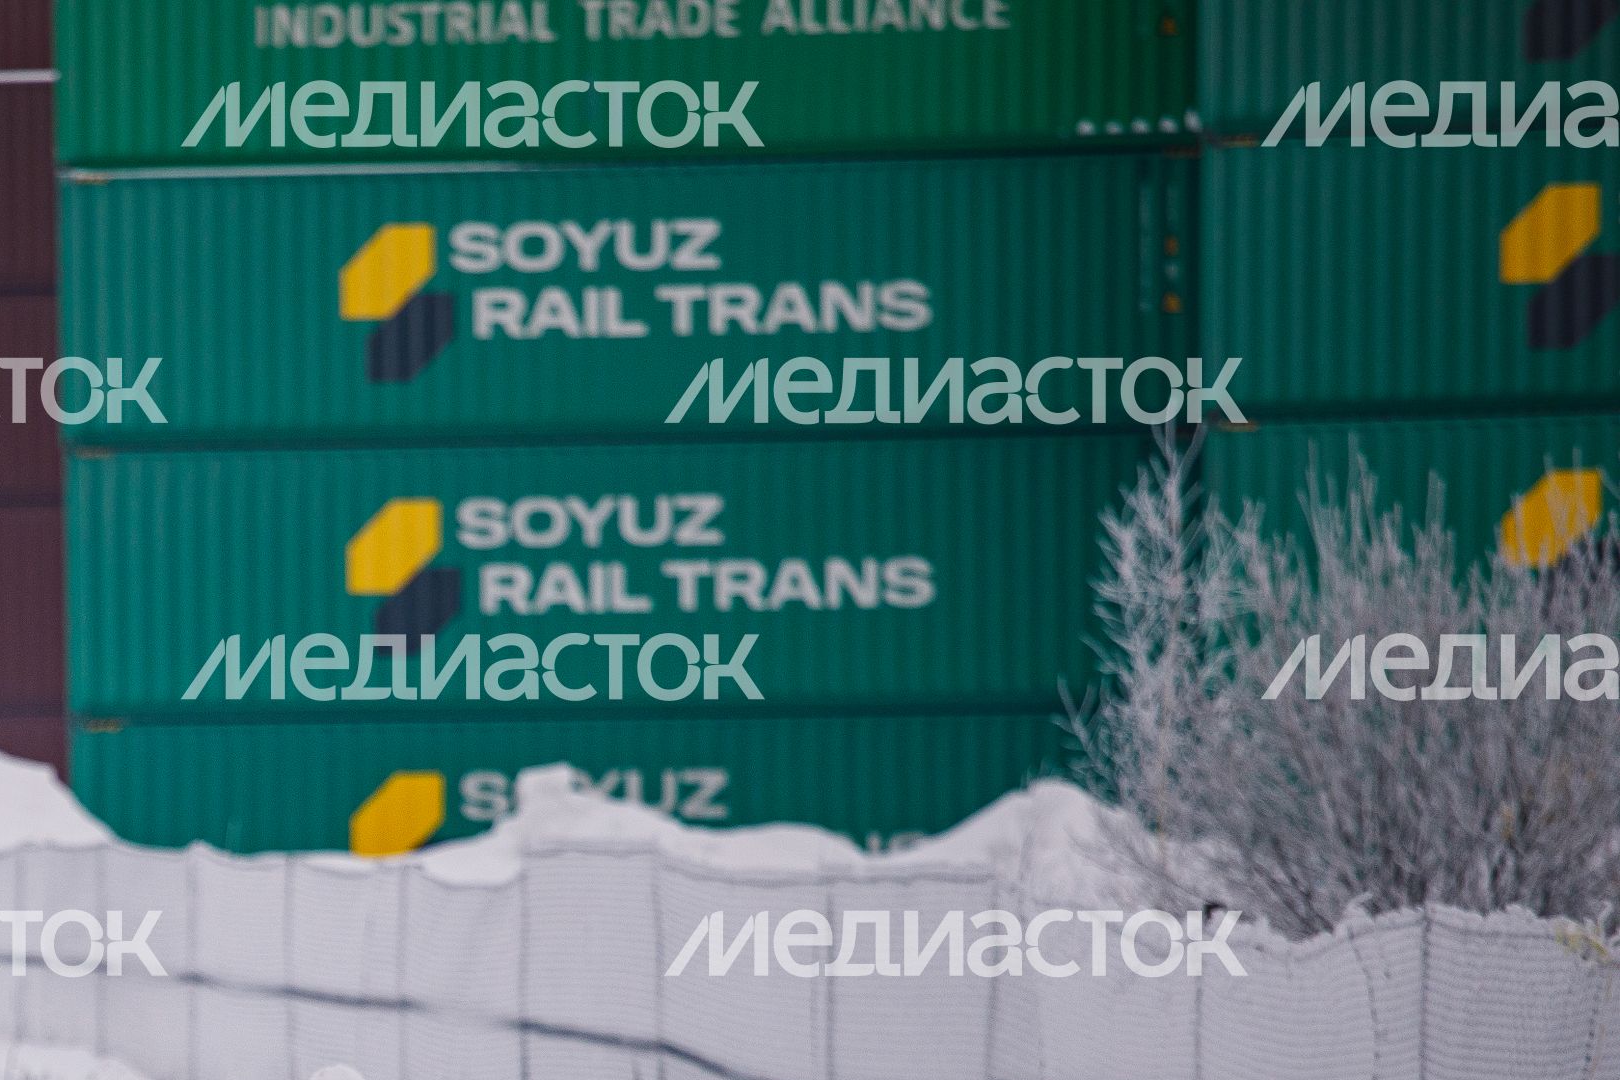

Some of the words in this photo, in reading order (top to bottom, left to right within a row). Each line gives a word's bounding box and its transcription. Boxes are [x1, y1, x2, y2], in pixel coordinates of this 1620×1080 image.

[254, 1, 558, 48] INDUSTRIAL
[578, 0, 741, 41] TRADE
[760, 0, 1012, 36] ALLIANCE
[449, 218, 721, 273] SOYUZ
[472, 285, 649, 340] RAIL
[654, 279, 933, 336] TRANS
[456, 493, 725, 549] SOYUZ
[479, 560, 653, 616] RAIL
[660, 556, 936, 612] TRANS
